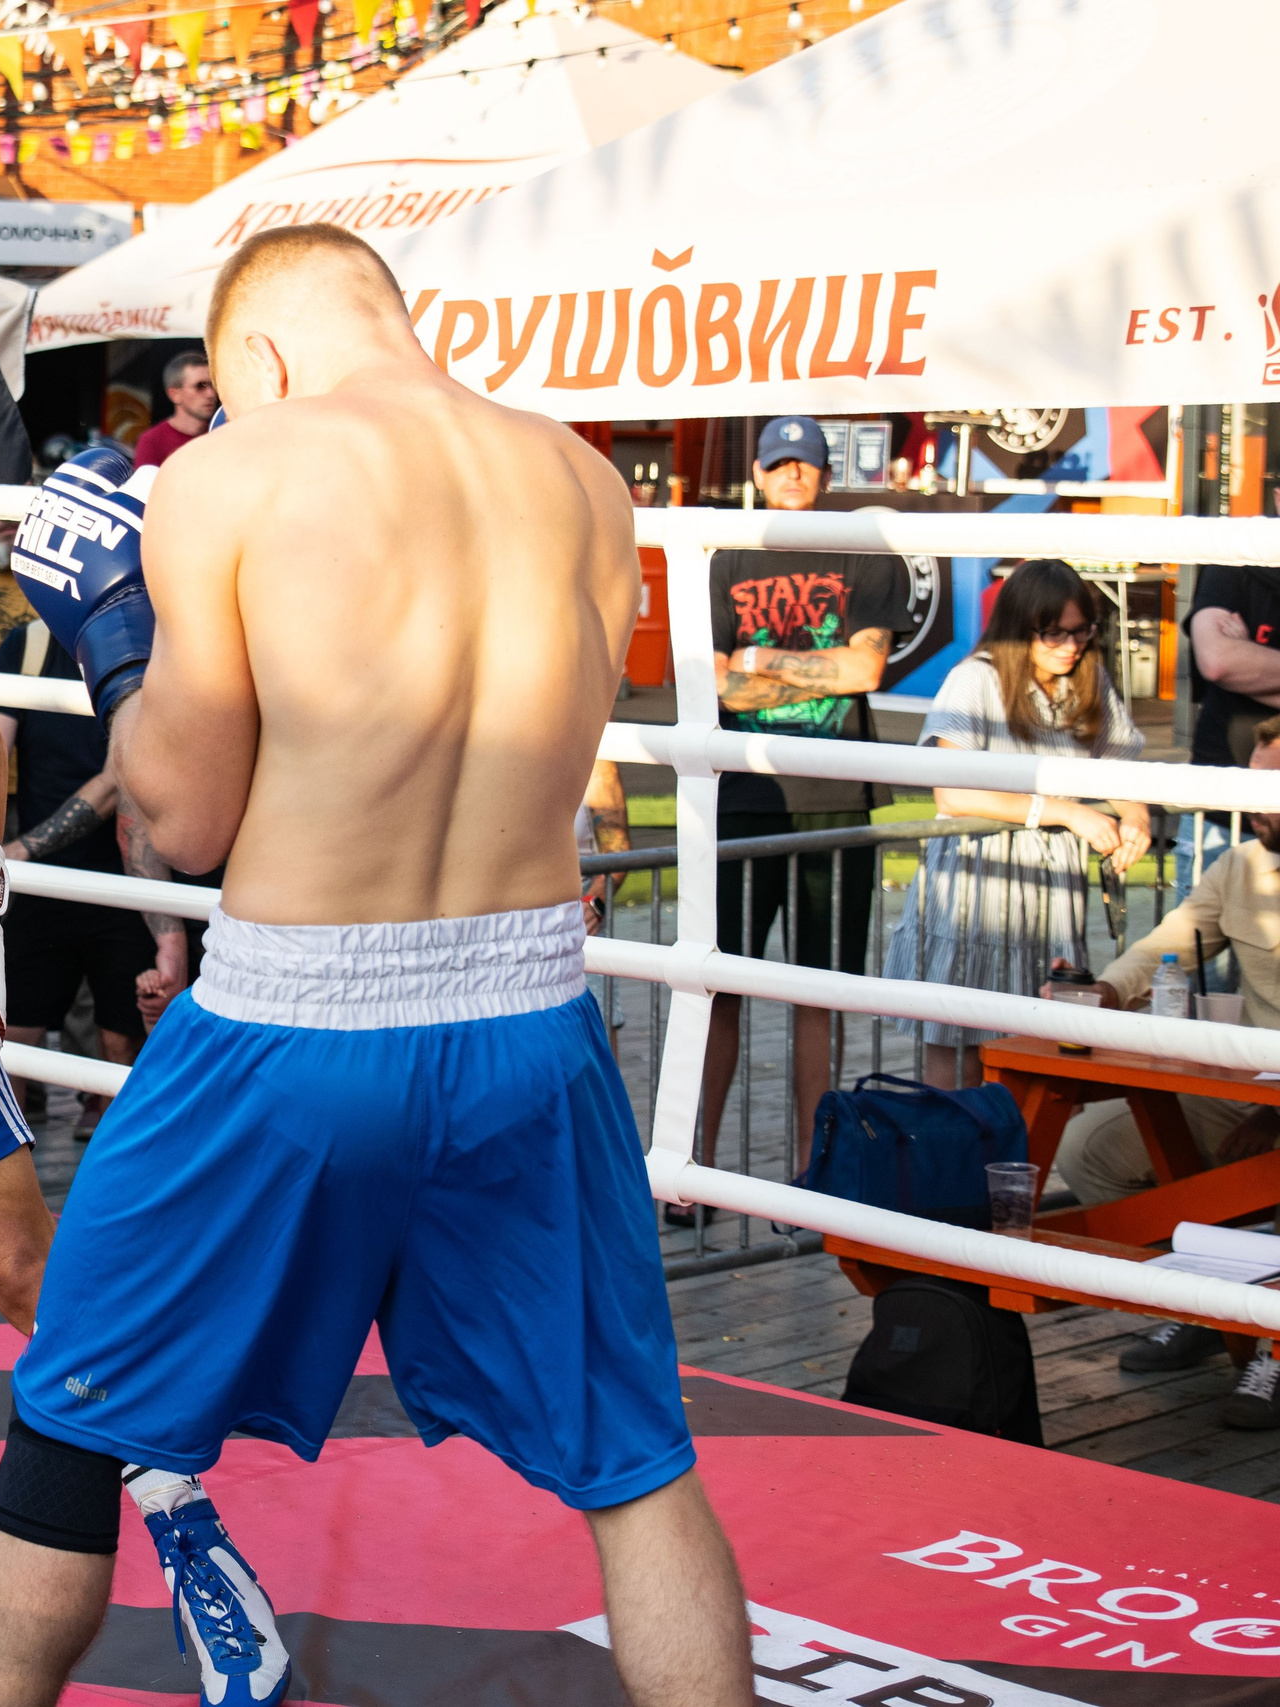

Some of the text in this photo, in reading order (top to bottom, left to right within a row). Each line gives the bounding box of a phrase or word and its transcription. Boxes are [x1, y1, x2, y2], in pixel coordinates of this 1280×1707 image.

[1125, 305, 1233, 346] EST.
[14, 513, 84, 574] HILL
[730, 573, 818, 616] STAY
[1000, 1614, 1181, 1668] GIN
